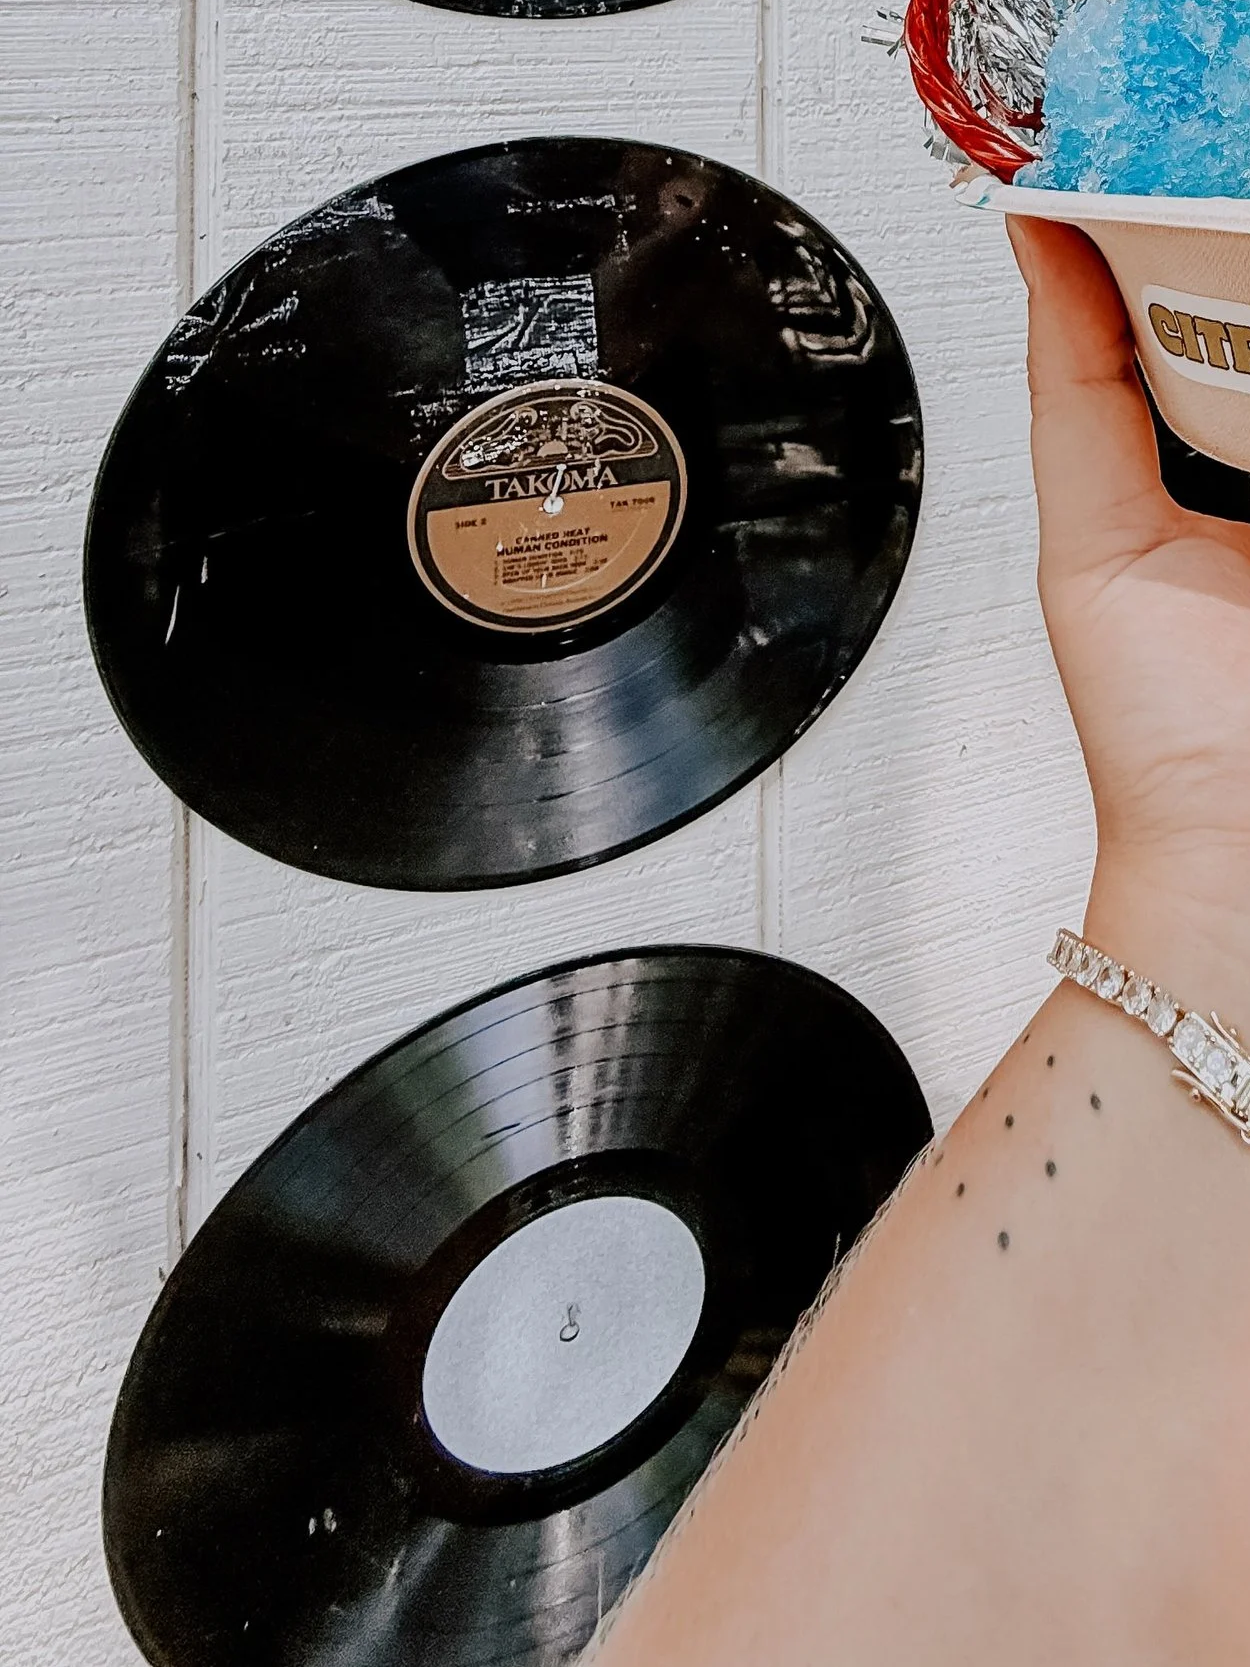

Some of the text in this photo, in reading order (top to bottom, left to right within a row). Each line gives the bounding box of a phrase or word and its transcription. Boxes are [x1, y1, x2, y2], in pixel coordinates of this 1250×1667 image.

[485, 466, 618, 501] TAKOMA
[455, 519, 477, 530] SIDE
[562, 526, 590, 539] HEAT
[497, 534, 608, 557] HUMAN CONDITION
